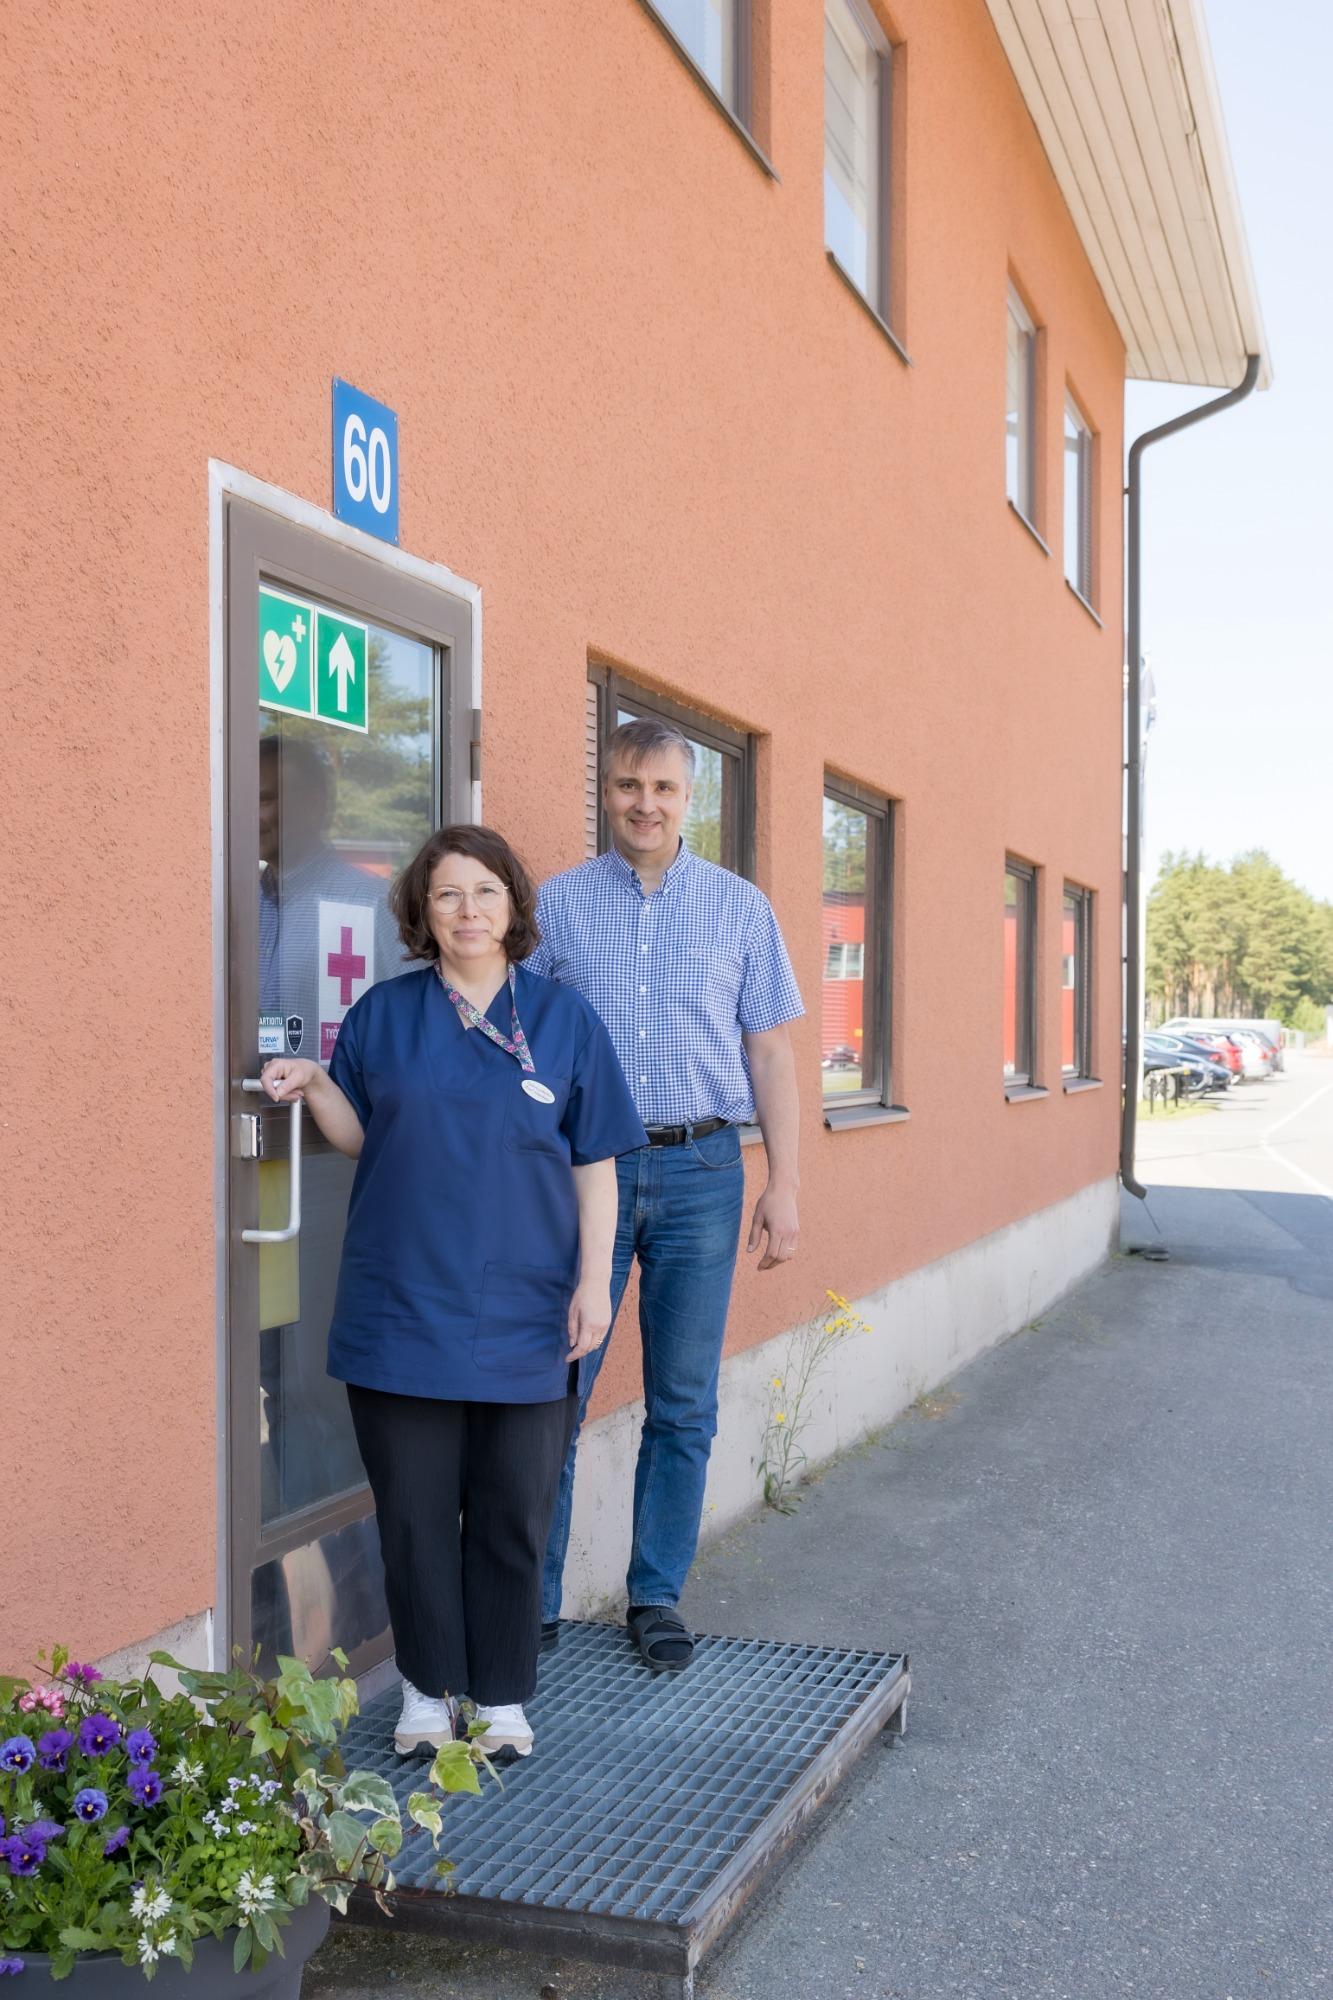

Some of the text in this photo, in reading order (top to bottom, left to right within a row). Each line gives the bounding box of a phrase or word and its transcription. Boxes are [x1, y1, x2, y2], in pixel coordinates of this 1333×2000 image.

[343, 413, 391, 514] 60
[259, 1016, 283, 1026] ARTIOITU
[325, 1025, 340, 1040] TYÖ
